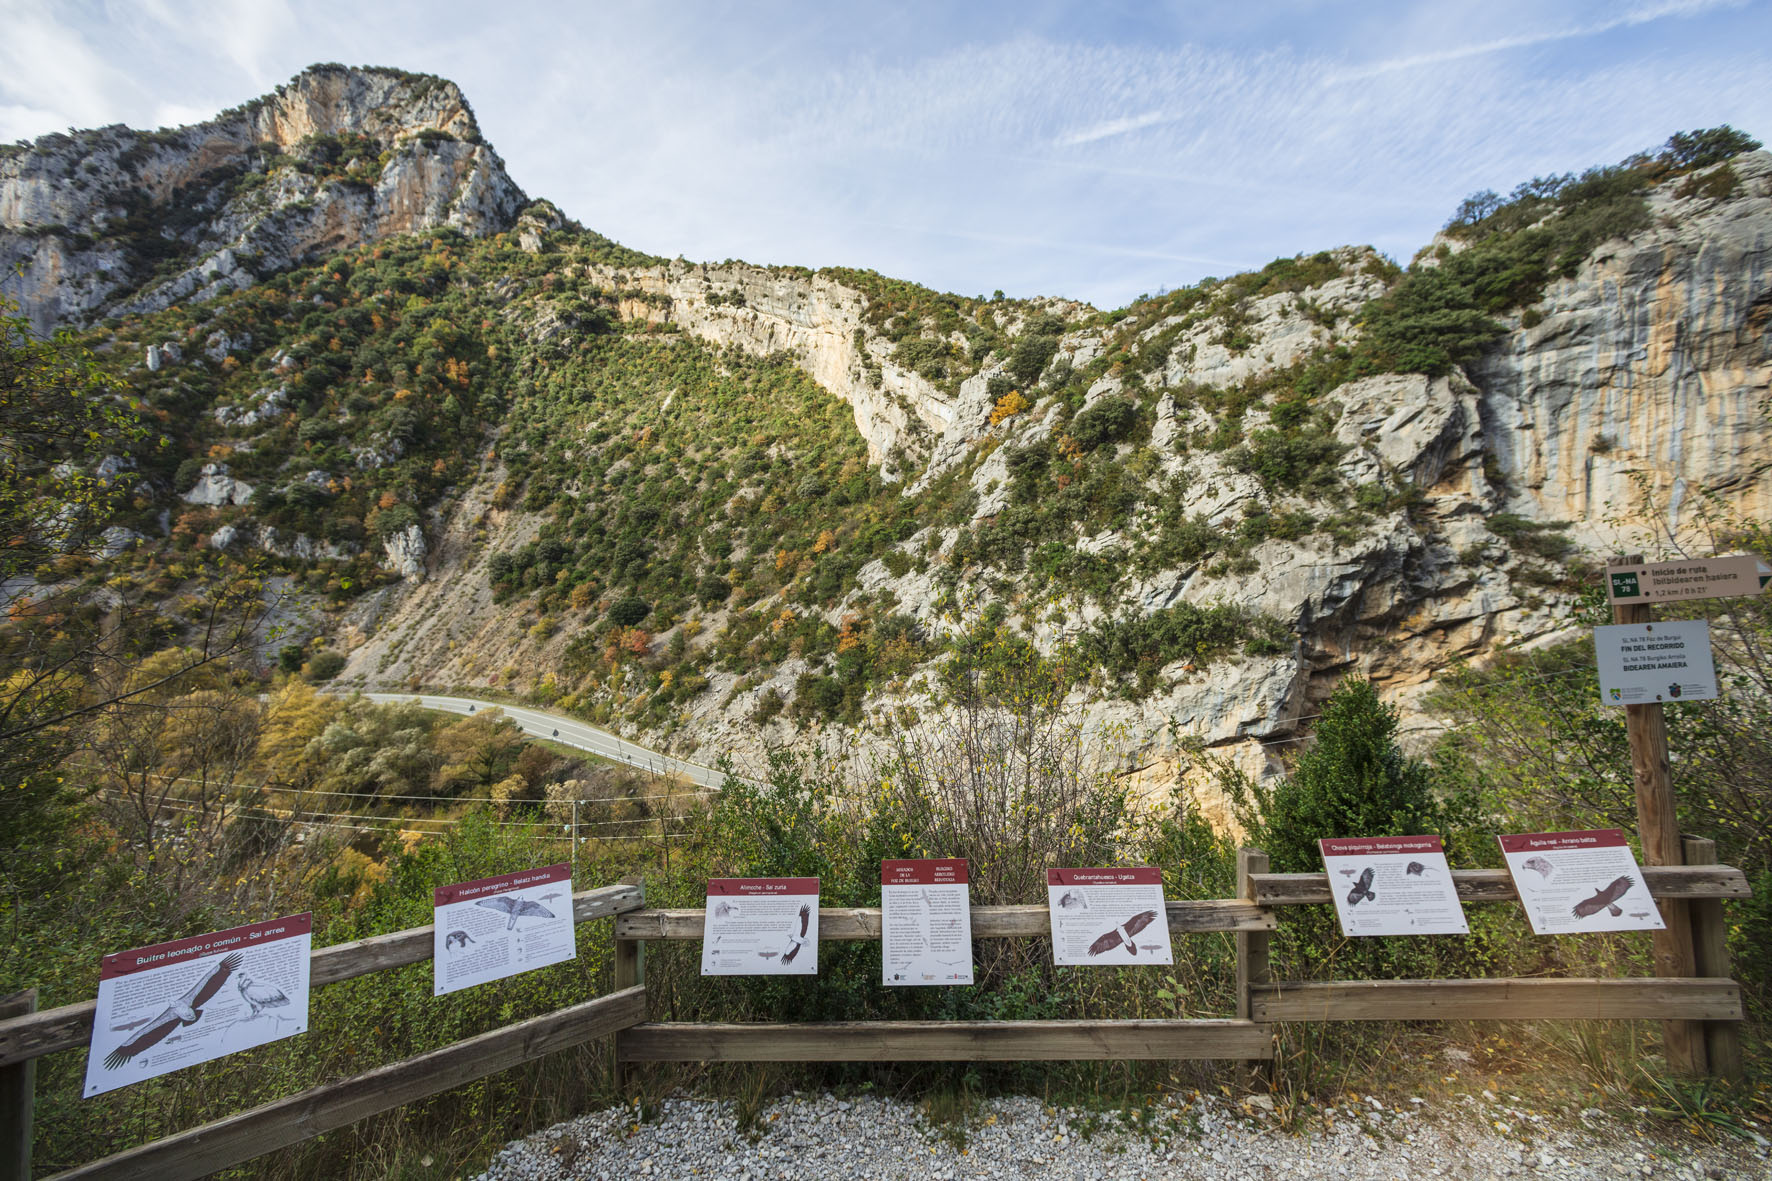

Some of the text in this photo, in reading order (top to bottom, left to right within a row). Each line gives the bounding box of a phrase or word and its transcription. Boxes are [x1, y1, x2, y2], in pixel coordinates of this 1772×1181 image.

[1705, 573, 1738, 581] hasiera
[459, 887, 480, 896] Halcón
[482, 881, 508, 893] peregrino
[136, 953, 165, 965] Buitre
[168, 945, 202, 958] leonado
[213, 936, 240, 947] común
[249, 931, 262, 940] Sai
[264, 927, 285, 936] arrea
